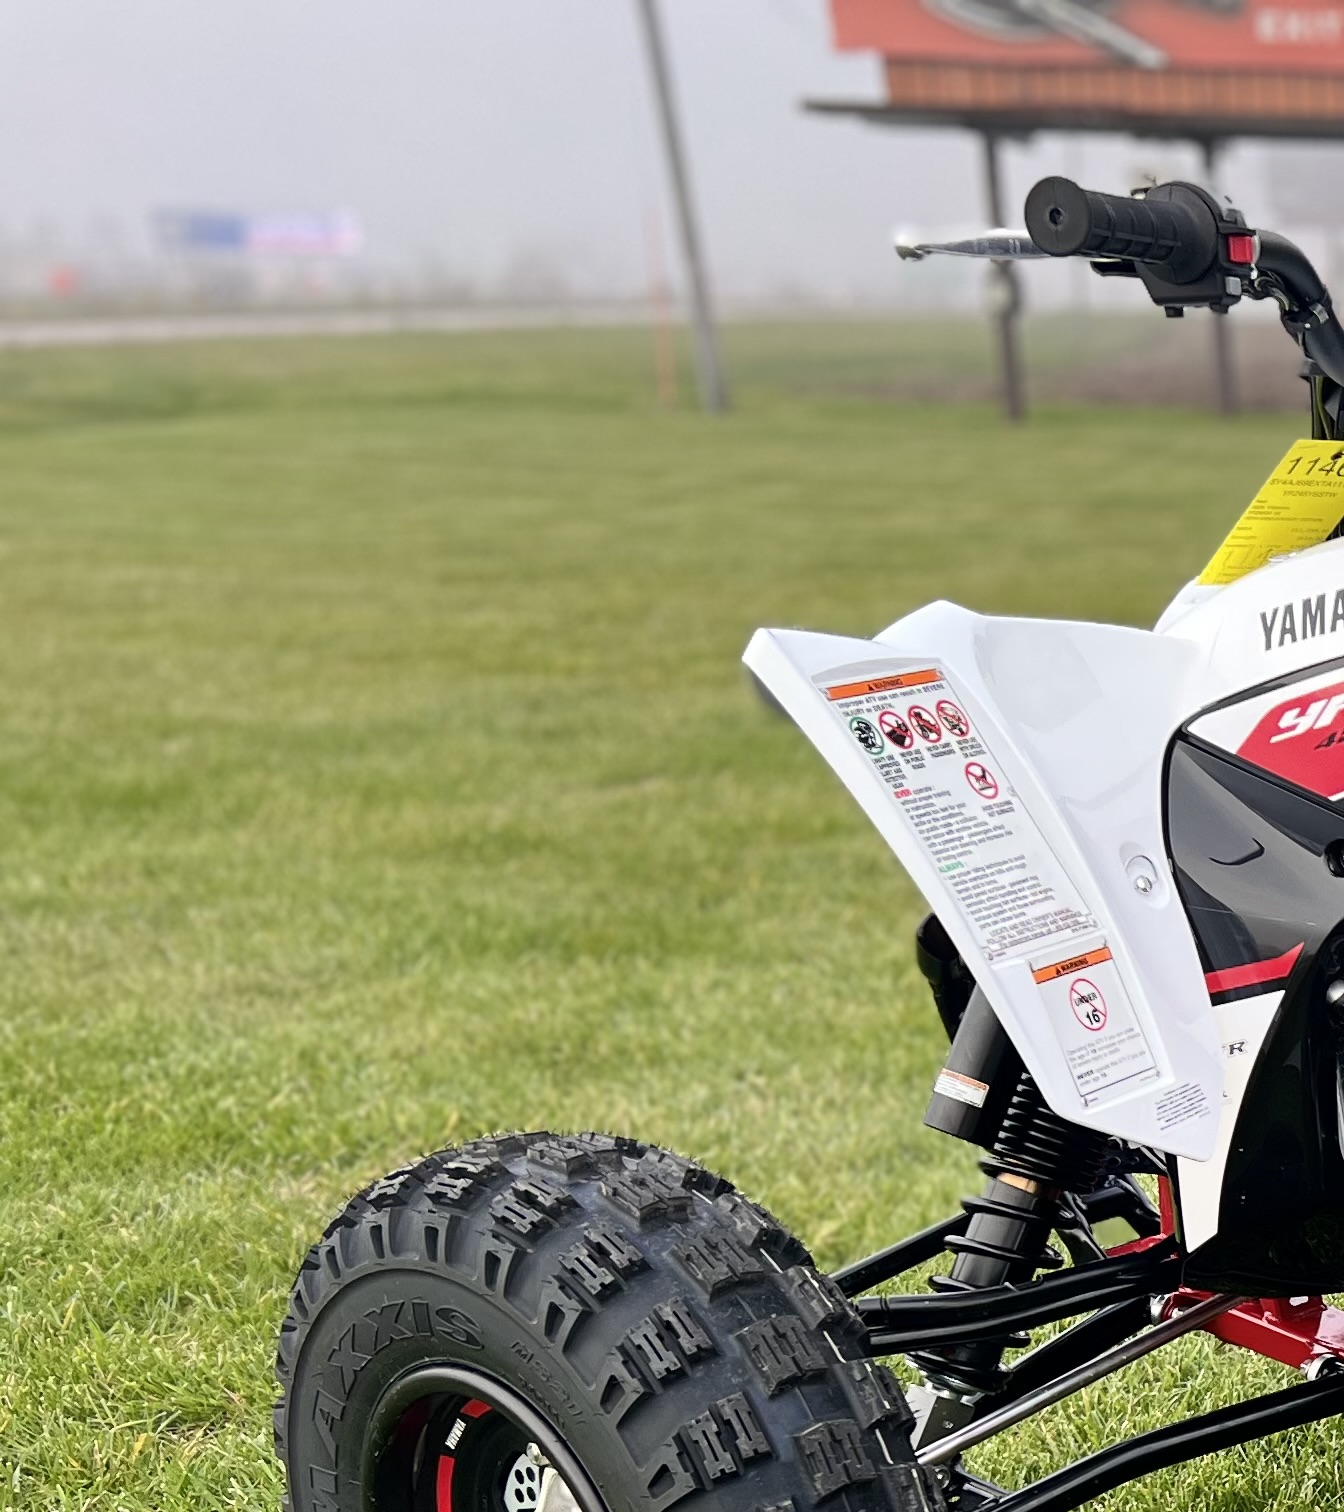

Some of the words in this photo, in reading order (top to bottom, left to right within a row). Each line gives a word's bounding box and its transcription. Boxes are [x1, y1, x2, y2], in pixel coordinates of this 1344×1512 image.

[1059, 956, 1089, 973] WARNING
[1072, 990, 1098, 1007] UNDER
[1083, 1007, 1102, 1027] 16
[444, 1418, 467, 1450] YAMAHA
